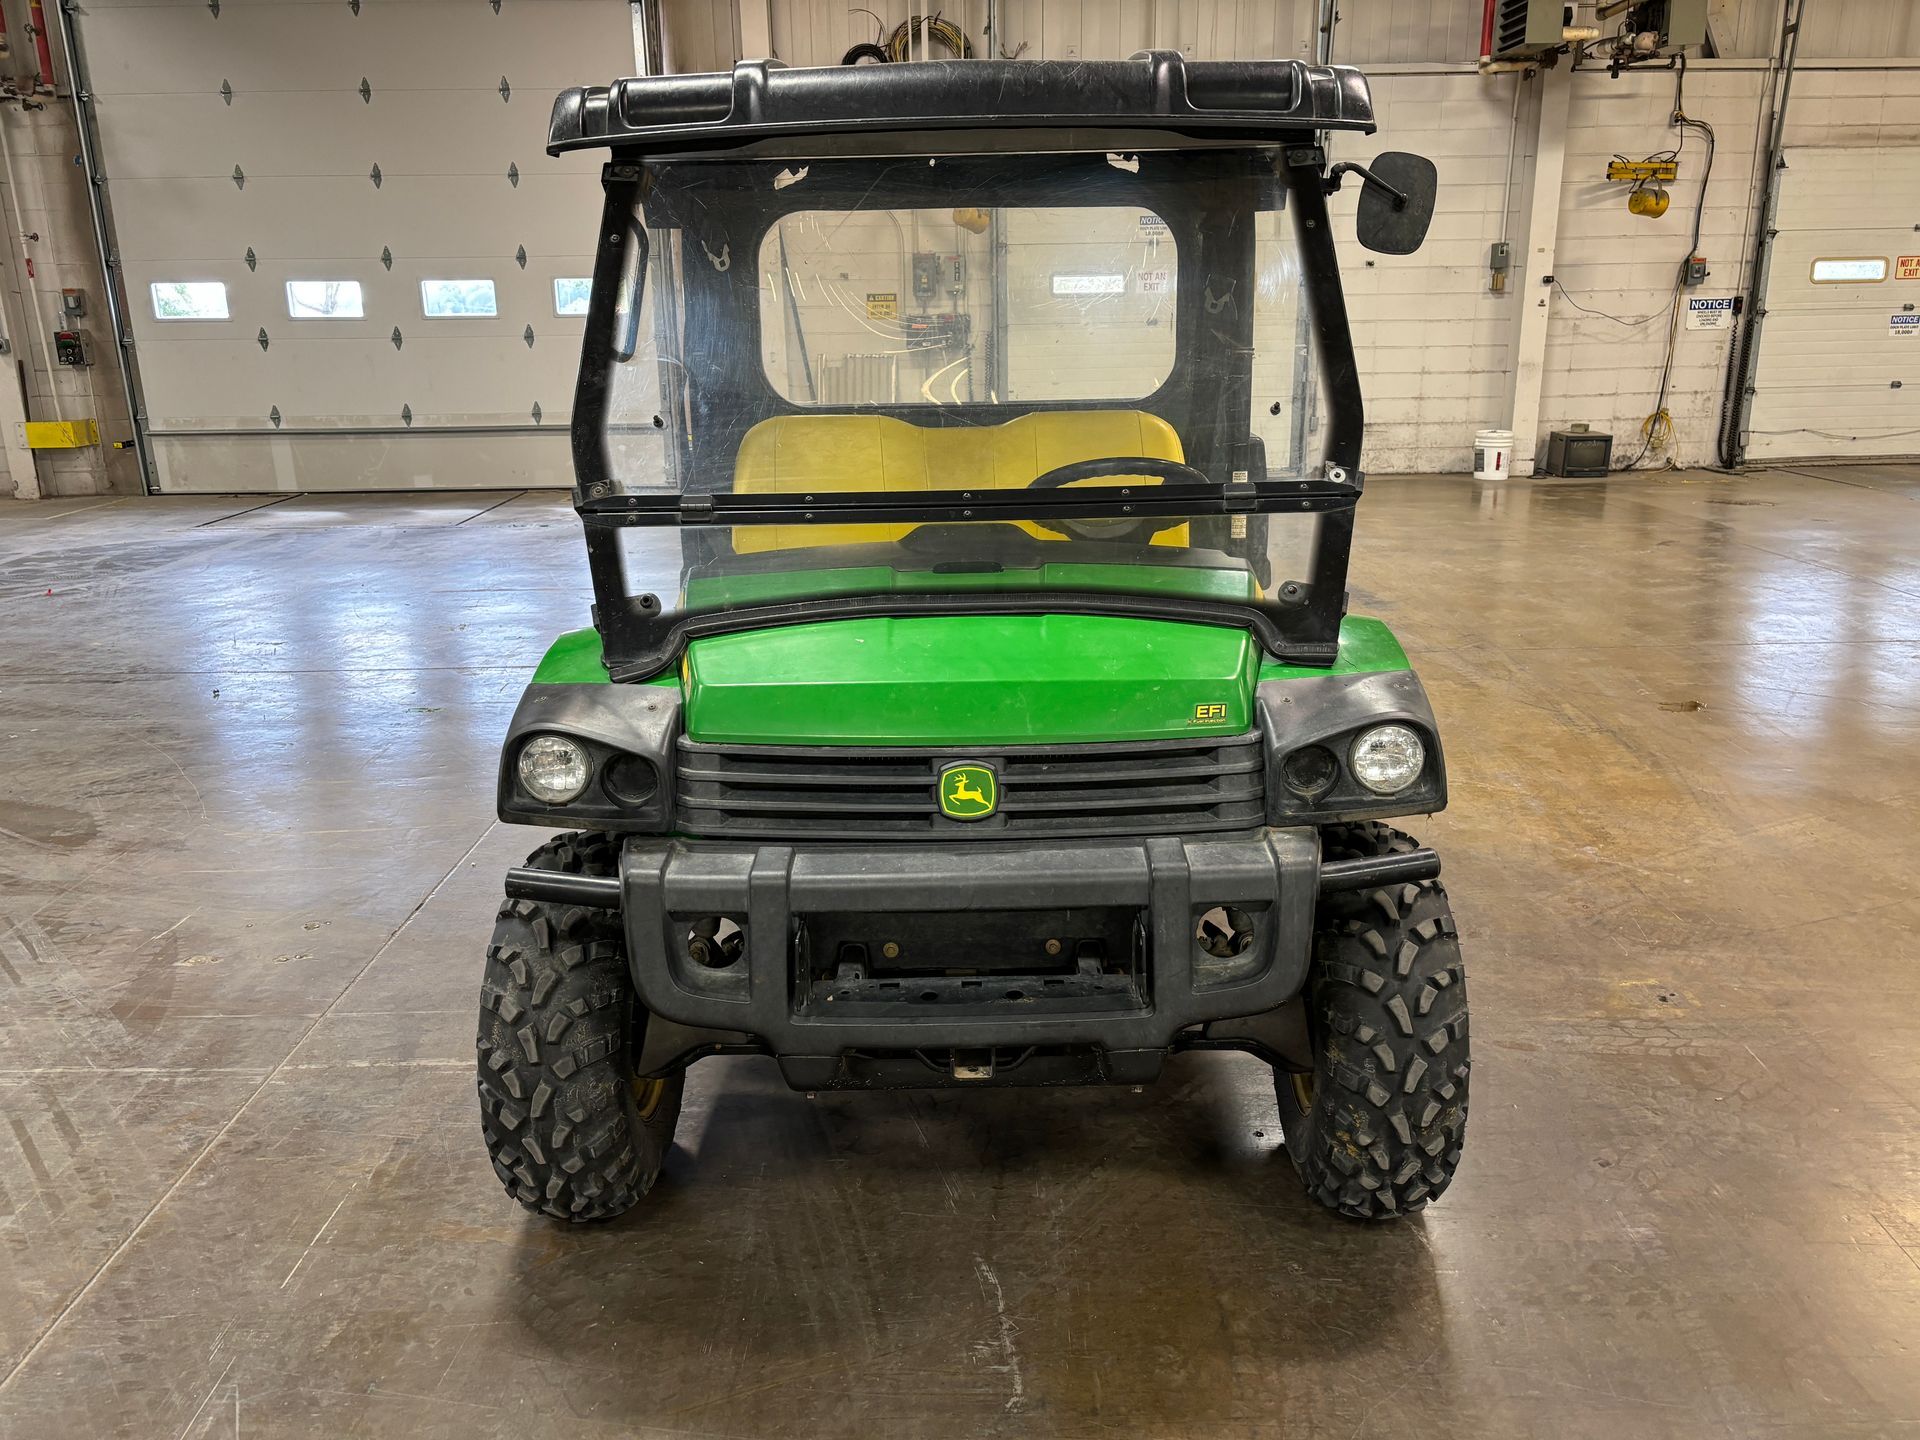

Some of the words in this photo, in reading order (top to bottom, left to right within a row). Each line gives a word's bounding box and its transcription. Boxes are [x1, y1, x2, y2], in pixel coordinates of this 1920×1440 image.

[1141, 216, 1165, 224] NOTIC
[1900, 259, 1914, 267] NOT
[1155, 272, 1167, 280] AN
[1904, 268, 1919, 276] EXIT
[1144, 283, 1160, 291] EXIT
[1691, 300, 1730, 309] NOTICE
[1196, 704, 1226, 718] EFI
